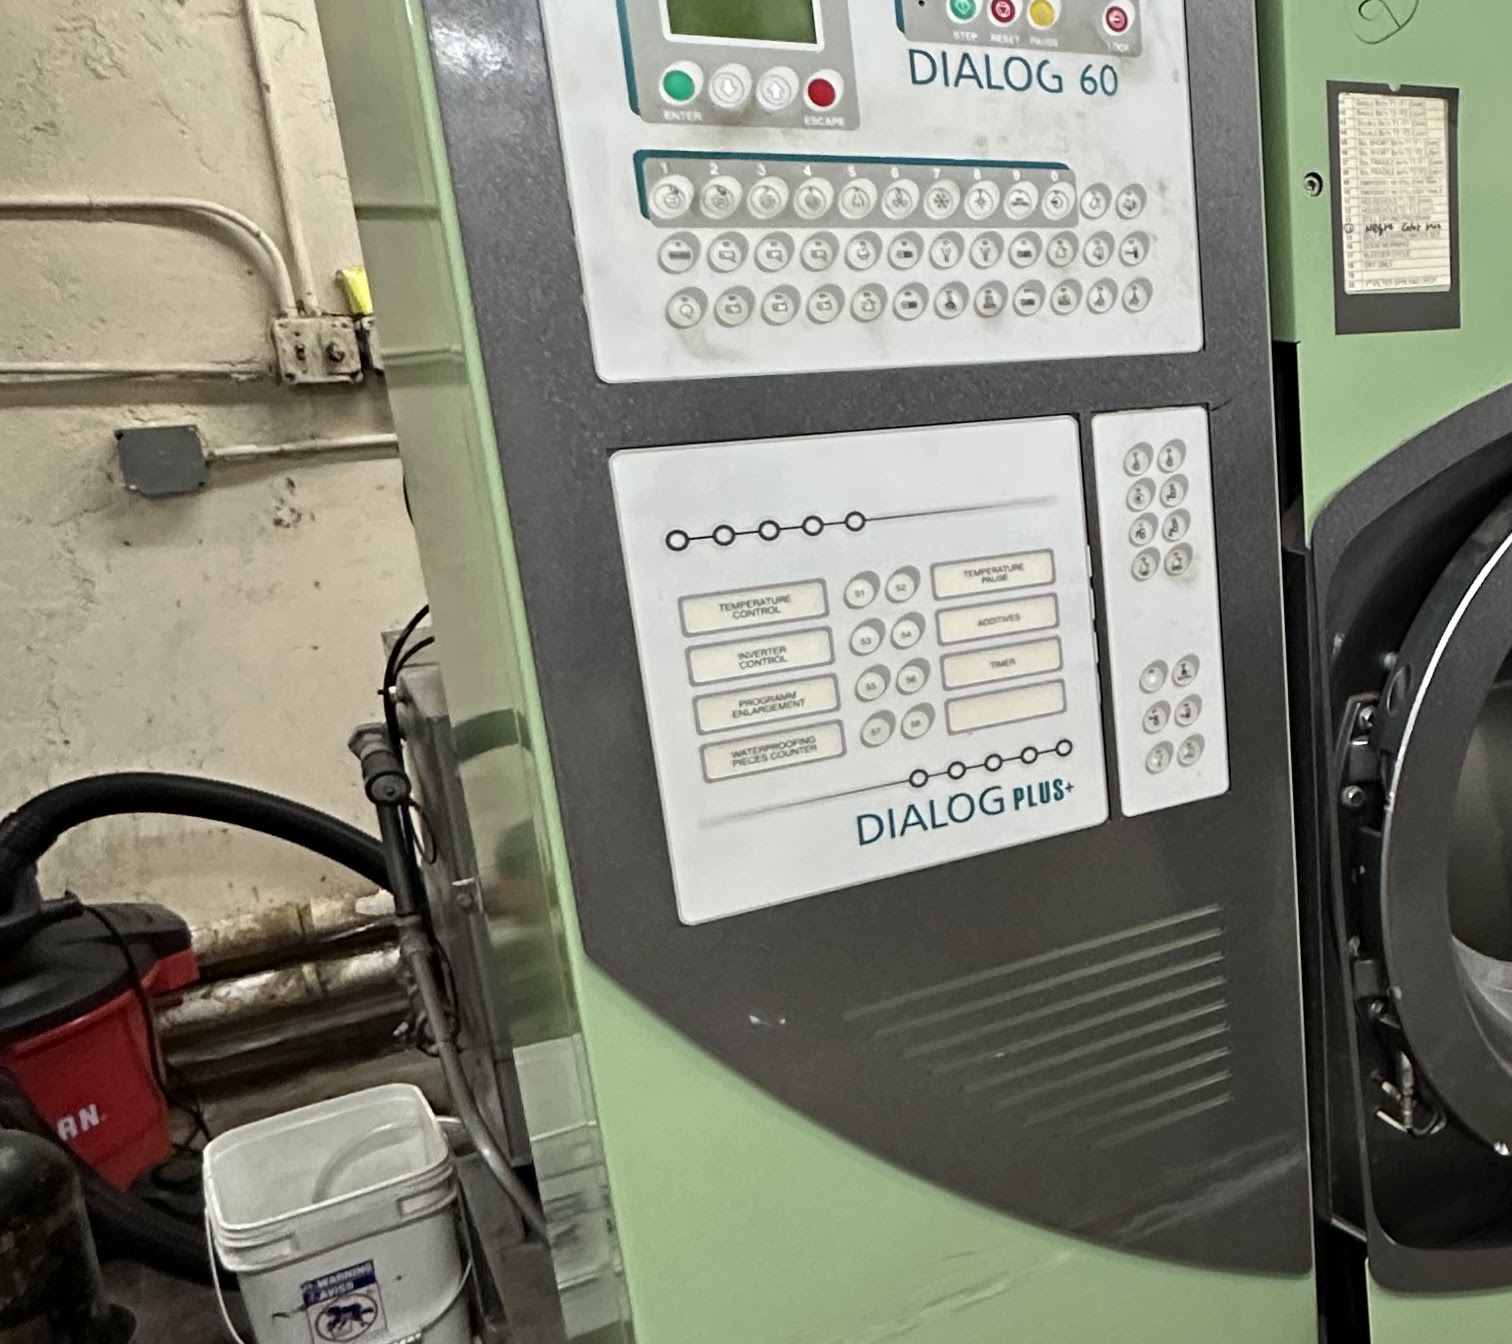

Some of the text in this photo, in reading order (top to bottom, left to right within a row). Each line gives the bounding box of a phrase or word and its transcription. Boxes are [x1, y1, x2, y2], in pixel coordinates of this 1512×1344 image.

[953, 31, 978, 42] STEP
[990, 33, 1021, 44] RESET
[908, 48, 1119, 96] DIALOG 60
[663, 110, 703, 122] ENTER
[804, 115, 846, 128] ESCAPE
[660, 163, 669, 174] 1
[709, 163, 720, 175] 2
[757, 164, 767, 177] 3
[803, 165, 813, 176] 4
[848, 166, 857, 177] 5
[932, 168, 941, 179] 7
[963, 563, 1024, 577] TEMPERATURE
[981, 574, 1008, 584] PAUSE
[719, 594, 791, 612] TEMPERATURE
[732, 606, 782, 620] CONTROL
[978, 613, 1021, 627] ADDITIVES
[738, 645, 787, 661] INVERTER
[739, 656, 788, 670] CONTROL
[990, 658, 1016, 669] TIMER
[738, 691, 797, 708] PROGRAMM
[732, 697, 806, 719] ENLARGEMENT
[731, 735, 816, 759] WATERPROOFING
[732, 743, 818, 767] PIECES COUNTER
[857, 785, 1006, 846] DIALOG
[320, 1281, 354, 1299] AVISO
